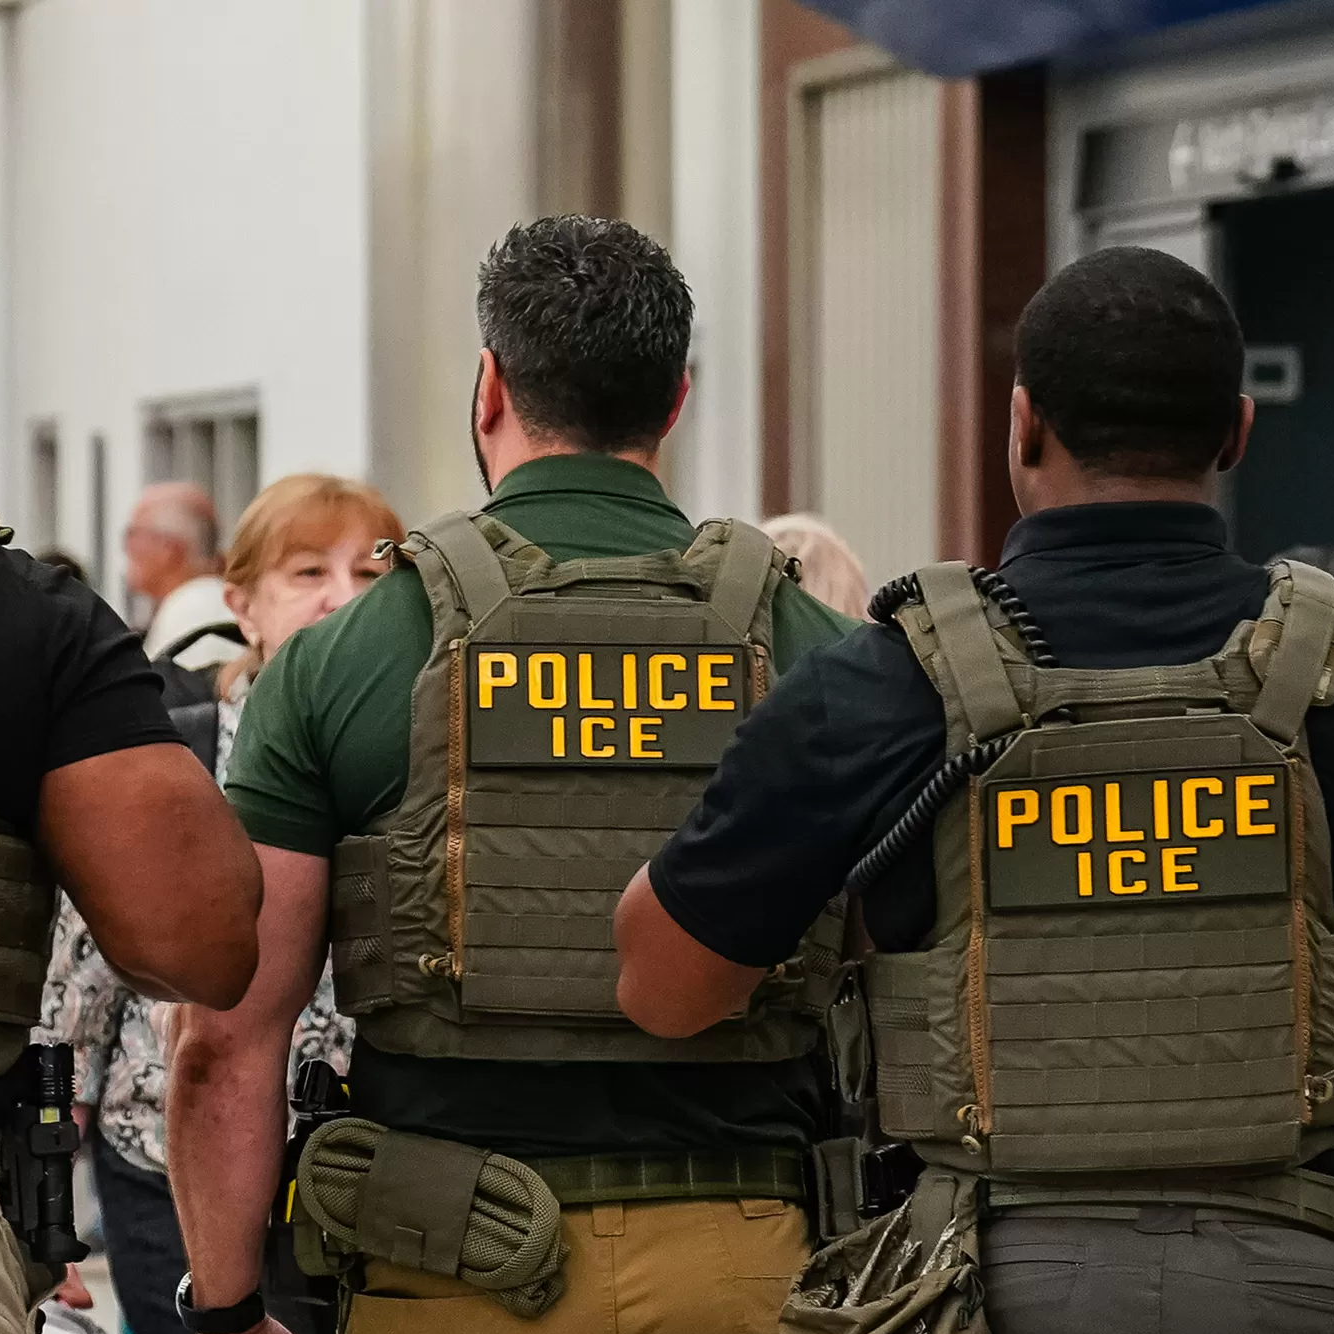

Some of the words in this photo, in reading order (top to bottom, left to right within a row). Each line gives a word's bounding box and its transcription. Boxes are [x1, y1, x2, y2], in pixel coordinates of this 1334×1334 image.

[478, 652, 735, 711] POLICE
[552, 716, 663, 758] ICE
[997, 774, 1277, 849] POLICE
[1077, 846, 1200, 897] ICE
